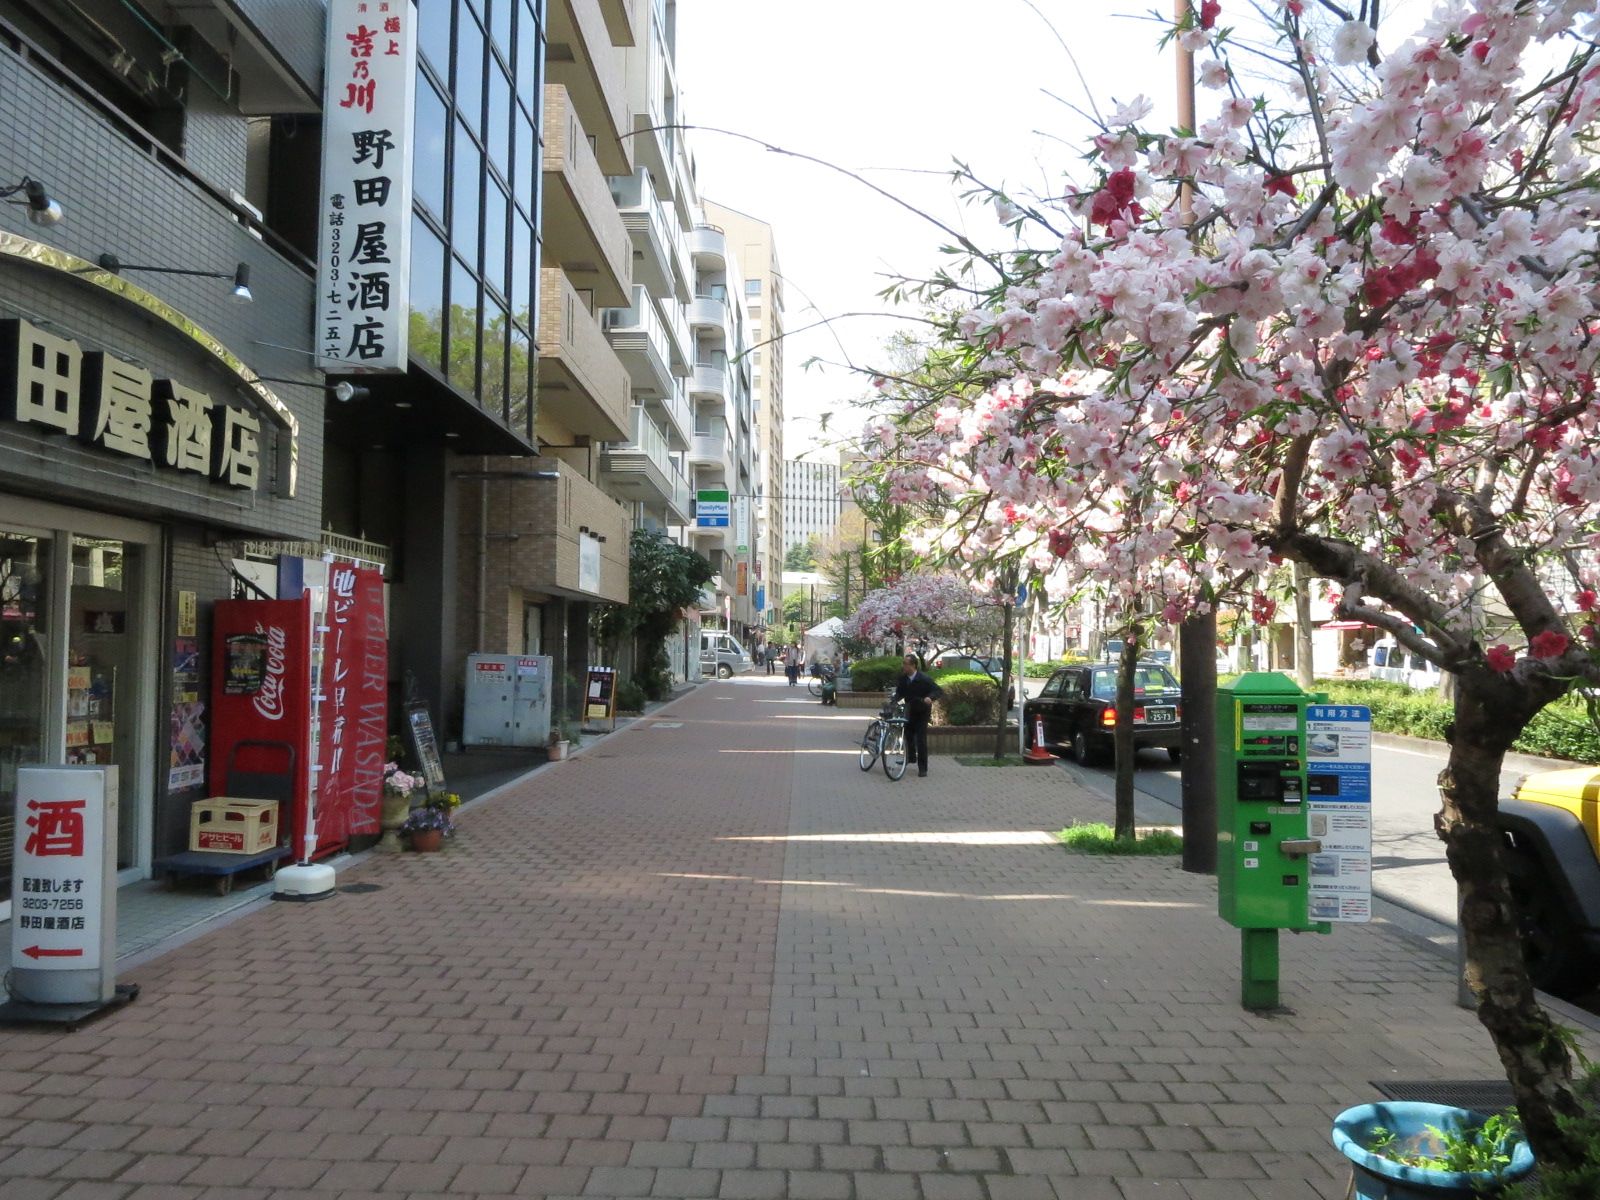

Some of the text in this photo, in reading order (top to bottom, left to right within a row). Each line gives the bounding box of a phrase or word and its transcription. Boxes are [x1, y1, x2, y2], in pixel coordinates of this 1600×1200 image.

[384, 16, 400, 56] 極上
[340, 24, 378, 114] 吉乃川
[346, 129, 395, 361] 野田屋酒店
[16, 317, 261, 491] 田屋酒店
[698, 504, 728, 512] FamilyMart
[1315, 708, 1361, 718] 利用方法
[351, 702, 385, 829] WASEDA
[24, 799, 87, 857] 酒
[200, 832, 243, 842] アサヒビール
[22, 877, 84, 894] 配達致します
[20, 915, 85, 931] 野田屋酒店
